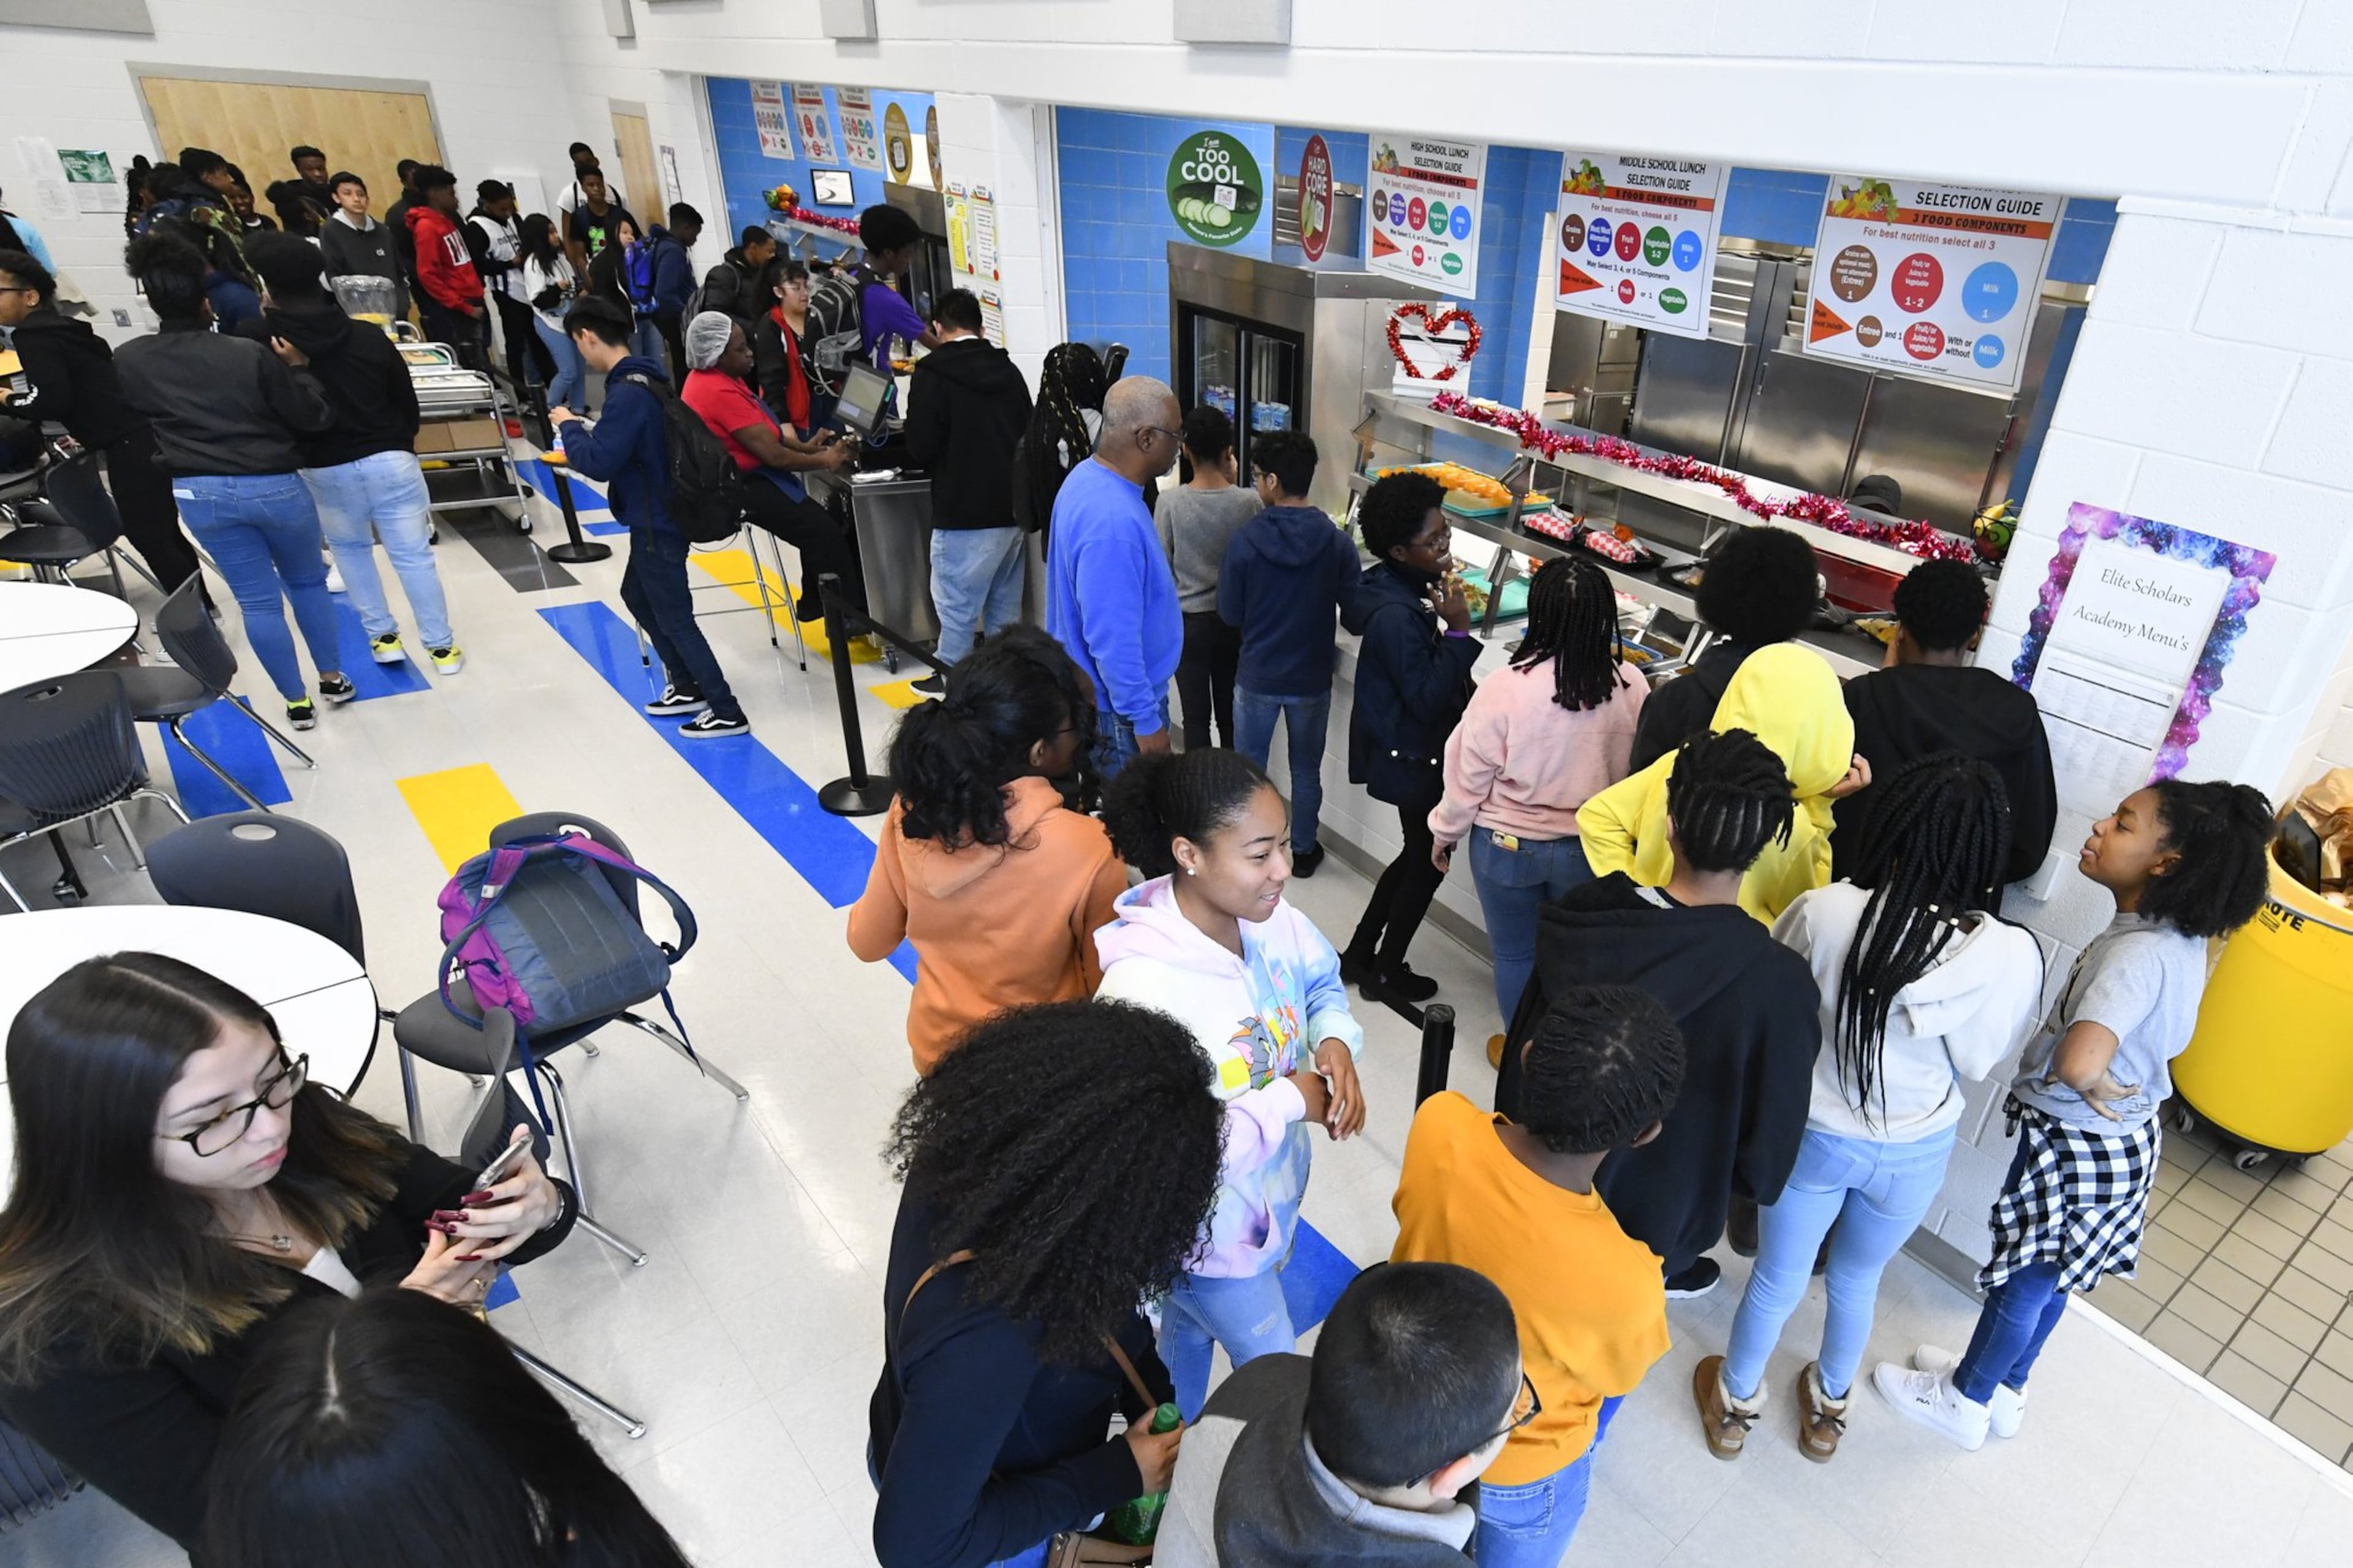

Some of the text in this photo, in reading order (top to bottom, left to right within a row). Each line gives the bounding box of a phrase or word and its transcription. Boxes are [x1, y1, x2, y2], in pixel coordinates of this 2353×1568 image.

[1196, 148, 1230, 164] TOO
[1411, 142, 1469, 159] HIGH SCHOOL LUNCH
[1308, 156, 1326, 173] HARD
[1414, 157, 1463, 173] SELECTION GUIDE
[1619, 156, 1706, 175] MIDDLE SCHOOL LUNCH
[1181, 161, 1244, 184] COOL
[1412, 170, 1428, 180] FOOD
[1306, 172, 1327, 197] CORE
[1627, 173, 1691, 191] SELECTION GUIDE
[1391, 179, 1401, 187] best
[1403, 181, 1425, 194] nutrition,
[1427, 187, 1446, 197] choose
[1622, 191, 1644, 201] FOOD
[1646, 194, 1697, 208] COMPONENTS
[1915, 191, 2043, 216] SELECTION GUIDE
[1601, 205, 1613, 213] best
[1615, 206, 1640, 218] nutrition,
[1642, 210, 1662, 220] choose
[1912, 213, 2027, 234] 3 FOOD COMPONENTS
[1565, 225, 1581, 234] Grains
[1622, 235, 1634, 244] Fruit
[1646, 238, 1670, 249] Vegetable
[1863, 226, 1995, 250] For best nutrition select all 3
[1912, 259, 1930, 268] Fruit/or
[1586, 260, 1596, 268] May
[1597, 262, 1612, 270] Select
[1637, 269, 1670, 281] Components
[1909, 269, 1929, 278] Juice/or
[1841, 276, 1864, 287] (Entree)
[1620, 286, 1632, 295] Fruit
[1983, 283, 2000, 294] Milk
[1661, 293, 1685, 305] Vegetable
[1847, 290, 1852, 300] 1
[1981, 309, 1988, 318] 1
[1859, 325, 1881, 336] Entree
[1914, 324, 1937, 334] Fruit/or
[1912, 333, 1936, 344] Juice/or
[1947, 336, 1972, 347] With or
[1909, 343, 1937, 354] vegetable
[1946, 347, 1971, 358] without
[1979, 345, 1998, 356] Milk
[2101, 569, 2192, 607] Elite Scholars
[2073, 605, 2189, 651] Academy Menu's
